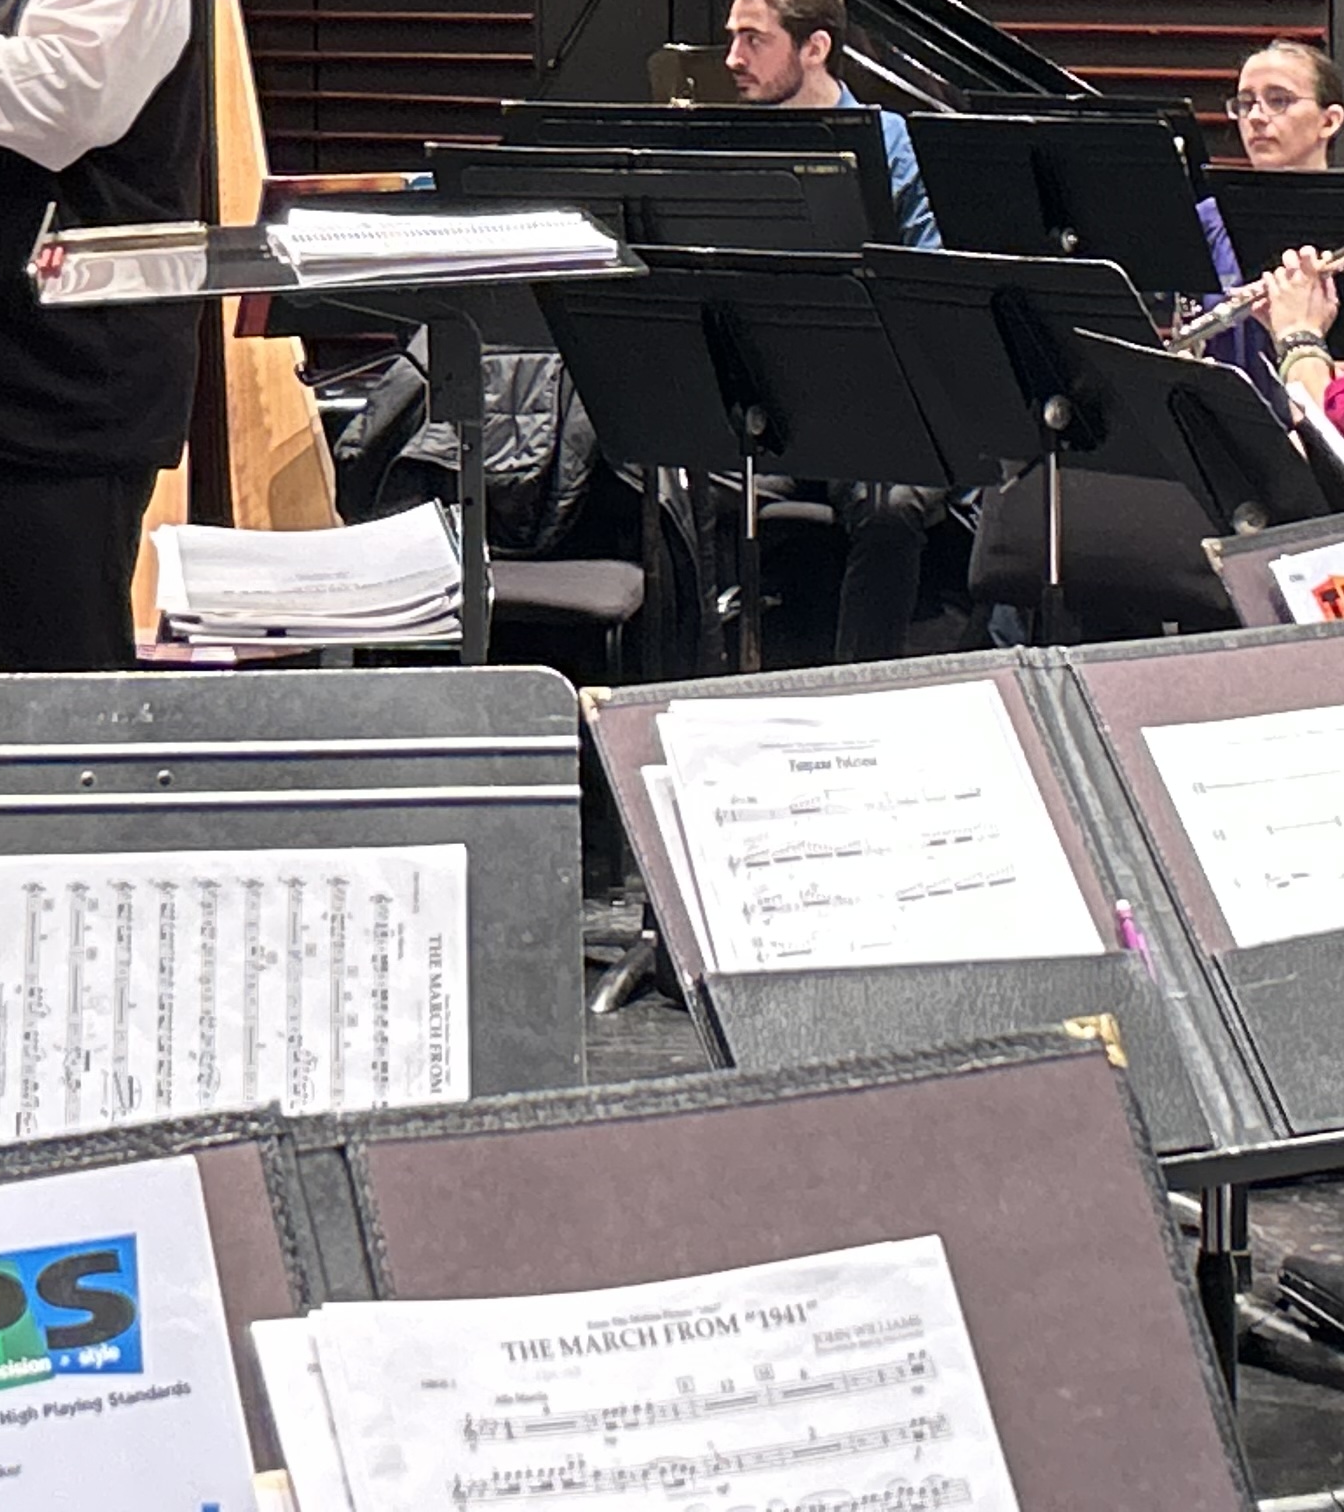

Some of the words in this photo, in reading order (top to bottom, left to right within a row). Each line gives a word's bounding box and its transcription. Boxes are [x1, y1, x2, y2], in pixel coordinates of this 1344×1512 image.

[78, 1344, 121, 1370] style
[501, 1339, 554, 1363] THE
[558, 1325, 658, 1357] MARCH
[663, 1313, 741, 1344] FROM
[0, 1406, 39, 1426] High
[44, 1396, 102, 1418] Playing
[109, 1380, 192, 1407] Standards
